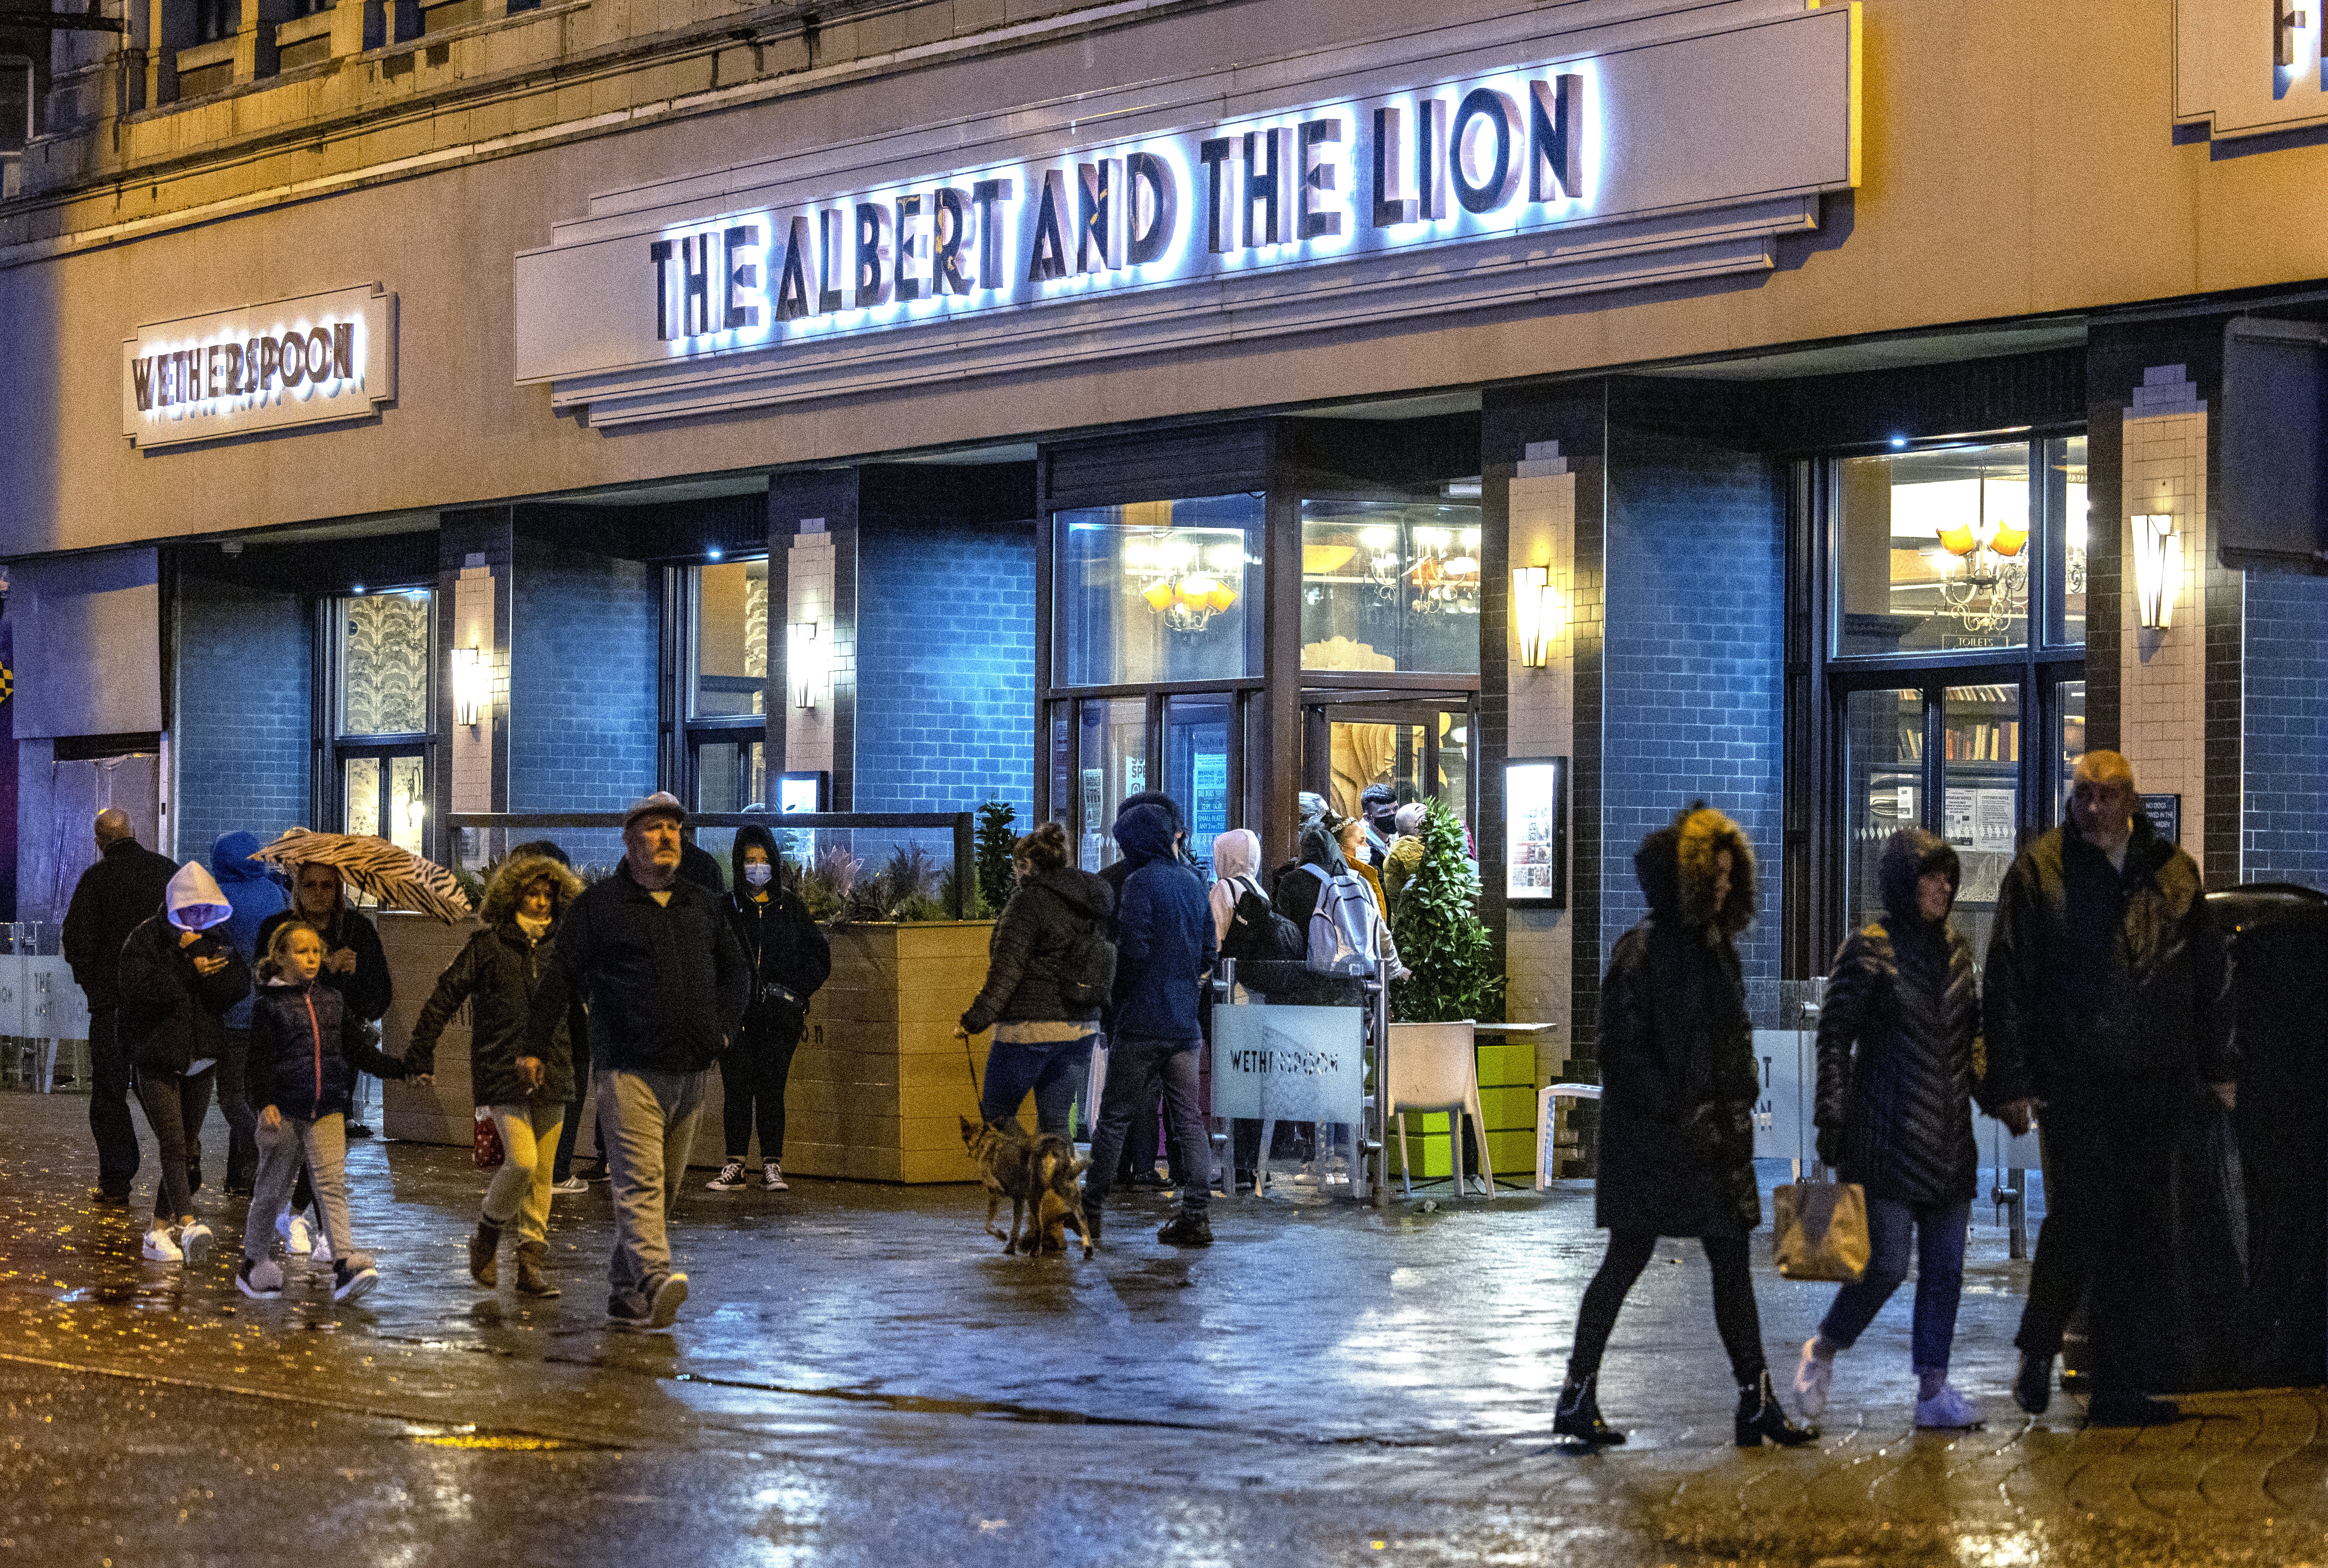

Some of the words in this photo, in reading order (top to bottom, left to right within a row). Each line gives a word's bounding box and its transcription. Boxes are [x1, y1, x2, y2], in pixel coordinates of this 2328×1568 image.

[650, 225, 759, 341] THE
[776, 179, 1013, 322] ALBERT
[1029, 152, 1177, 282] AND
[1200, 118, 1342, 254] THE
[1374, 74, 1584, 229] LION
[132, 322, 354, 412] WETHERSPOON
[1957, 637, 1993, 647] TOILETS
